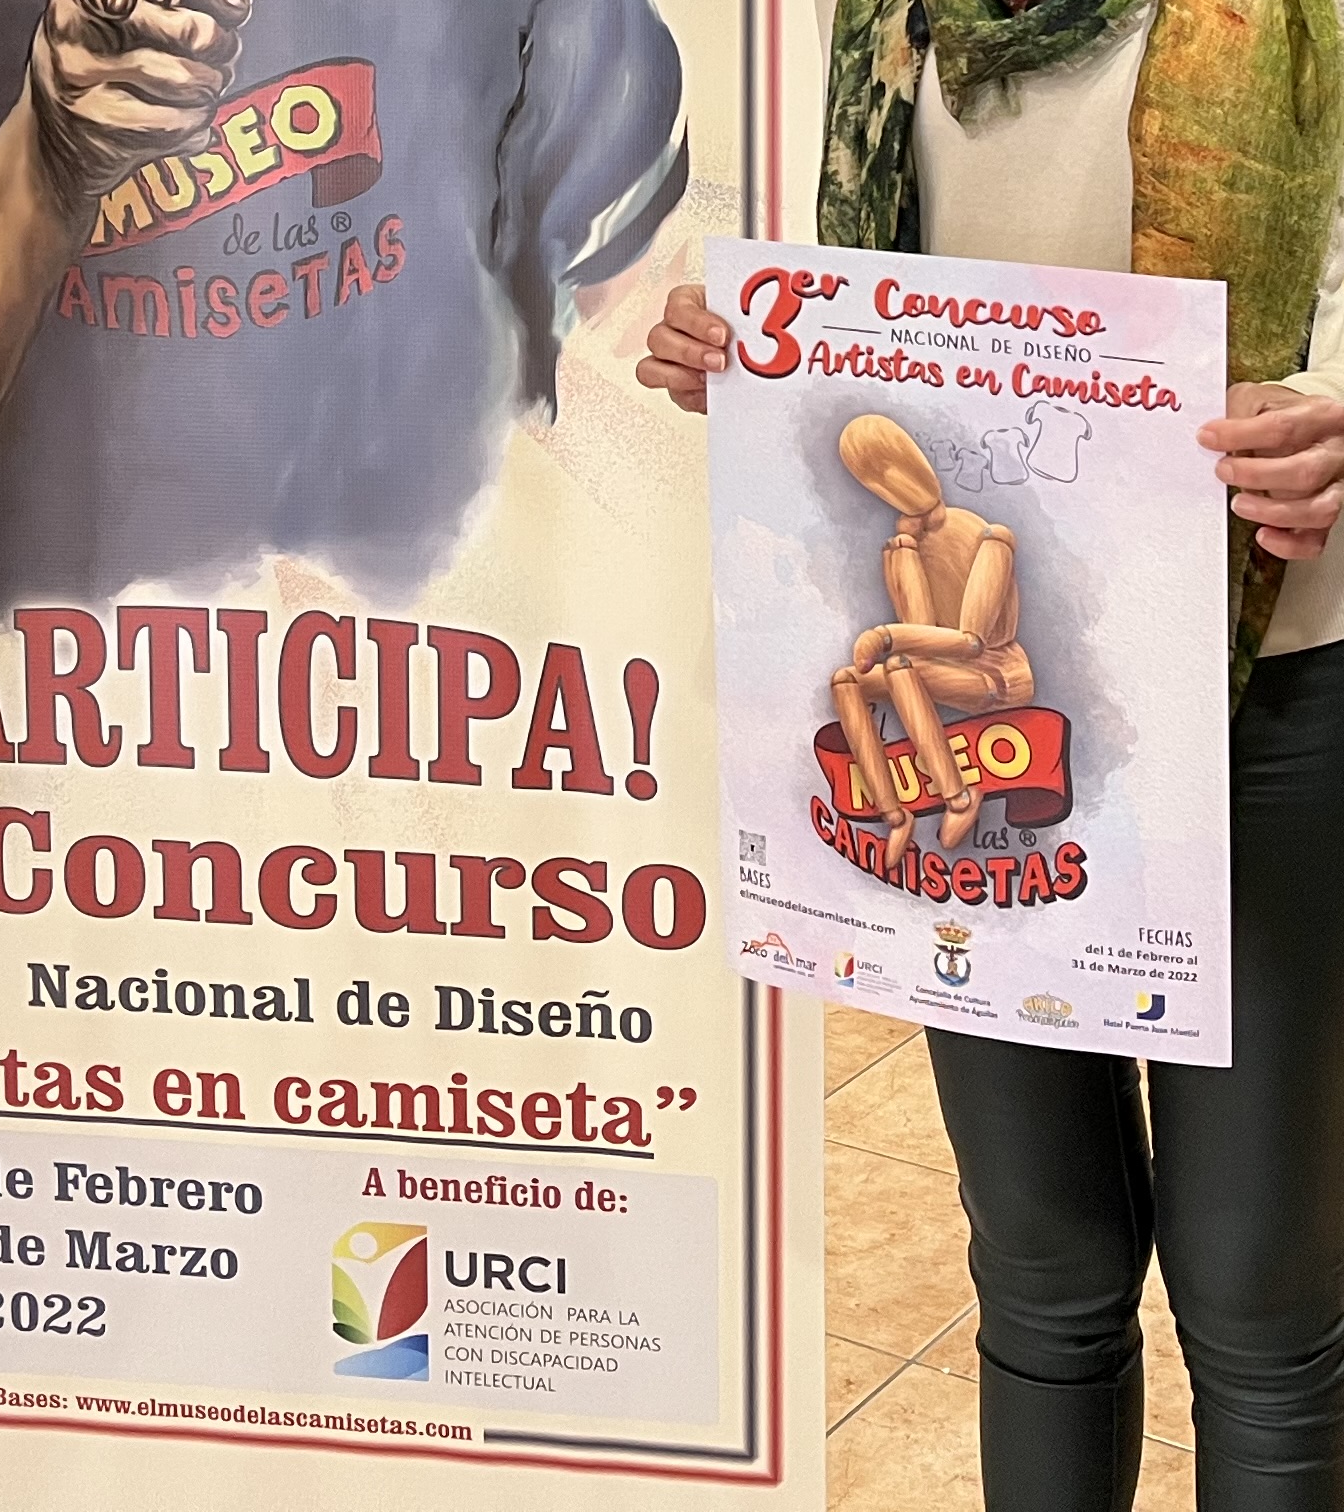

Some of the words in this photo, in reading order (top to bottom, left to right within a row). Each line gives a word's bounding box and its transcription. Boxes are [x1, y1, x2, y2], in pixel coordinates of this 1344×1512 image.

[91, 84, 342, 246] MUSEO
[223, 213, 263, 255] de
[273, 212, 320, 251] las
[874, 278, 1106, 337] Concurso
[891, 328, 980, 352] NACIONAL
[991, 339, 1012, 354] DE
[1024, 342, 1091, 364] DISEÑO
[808, 340, 944, 387] Artistas
[956, 363, 1002, 395] en
[1011, 363, 1182, 412] Camiseta
[740, 866, 771, 888] BASES
[740, 889, 896, 935] elmuseodelascamisetas.com
[1085, 944, 1104, 955] del
[1107, 947, 1114, 956] 1
[1117, 948, 1133, 959] de
[1136, 950, 1184, 964] Febrero
[1187, 955, 1198, 965] al
[1138, 927, 1193, 948] FECHAS
[773, 950, 790, 965] del
[796, 957, 817, 971] mar
[856, 959, 883, 974] URCI
[1071, 959, 1086, 970] 31
[1089, 961, 1104, 972] de
[1107, 964, 1146, 977] Marzo
[1149, 968, 1165, 979] de
[1168, 970, 1198, 982] 2022
[27, 963, 314, 1024] Nacional
[337, 980, 411, 1029] de
[434, 985, 653, 1044] Diseño
[153, 1067, 246, 1121] en
[54, 1161, 264, 1215] Febrero
[361, 1168, 387, 1198] A
[397, 1169, 562, 1210] beneficio
[574, 1181, 628, 1214] de:
[65, 1229, 239, 1280] Marzo
[444, 1250, 567, 1295] URCI
[444, 1299, 554, 1320] ASOCIACIÓN
[567, 1307, 612, 1325] PARA
[618, 1311, 641, 1327] LA
[444, 1322, 532, 1343] ATENCIÓN
[540, 1328, 562, 1345] DE
[569, 1331, 662, 1353] PERSONAS
[444, 1345, 484, 1363] CON
[490, 1349, 619, 1373] DISCAPACIDAD
[444, 1369, 557, 1393] INTELECTUAL
[76, 1394, 473, 1441] www.elmuseodelascamisetas.com
